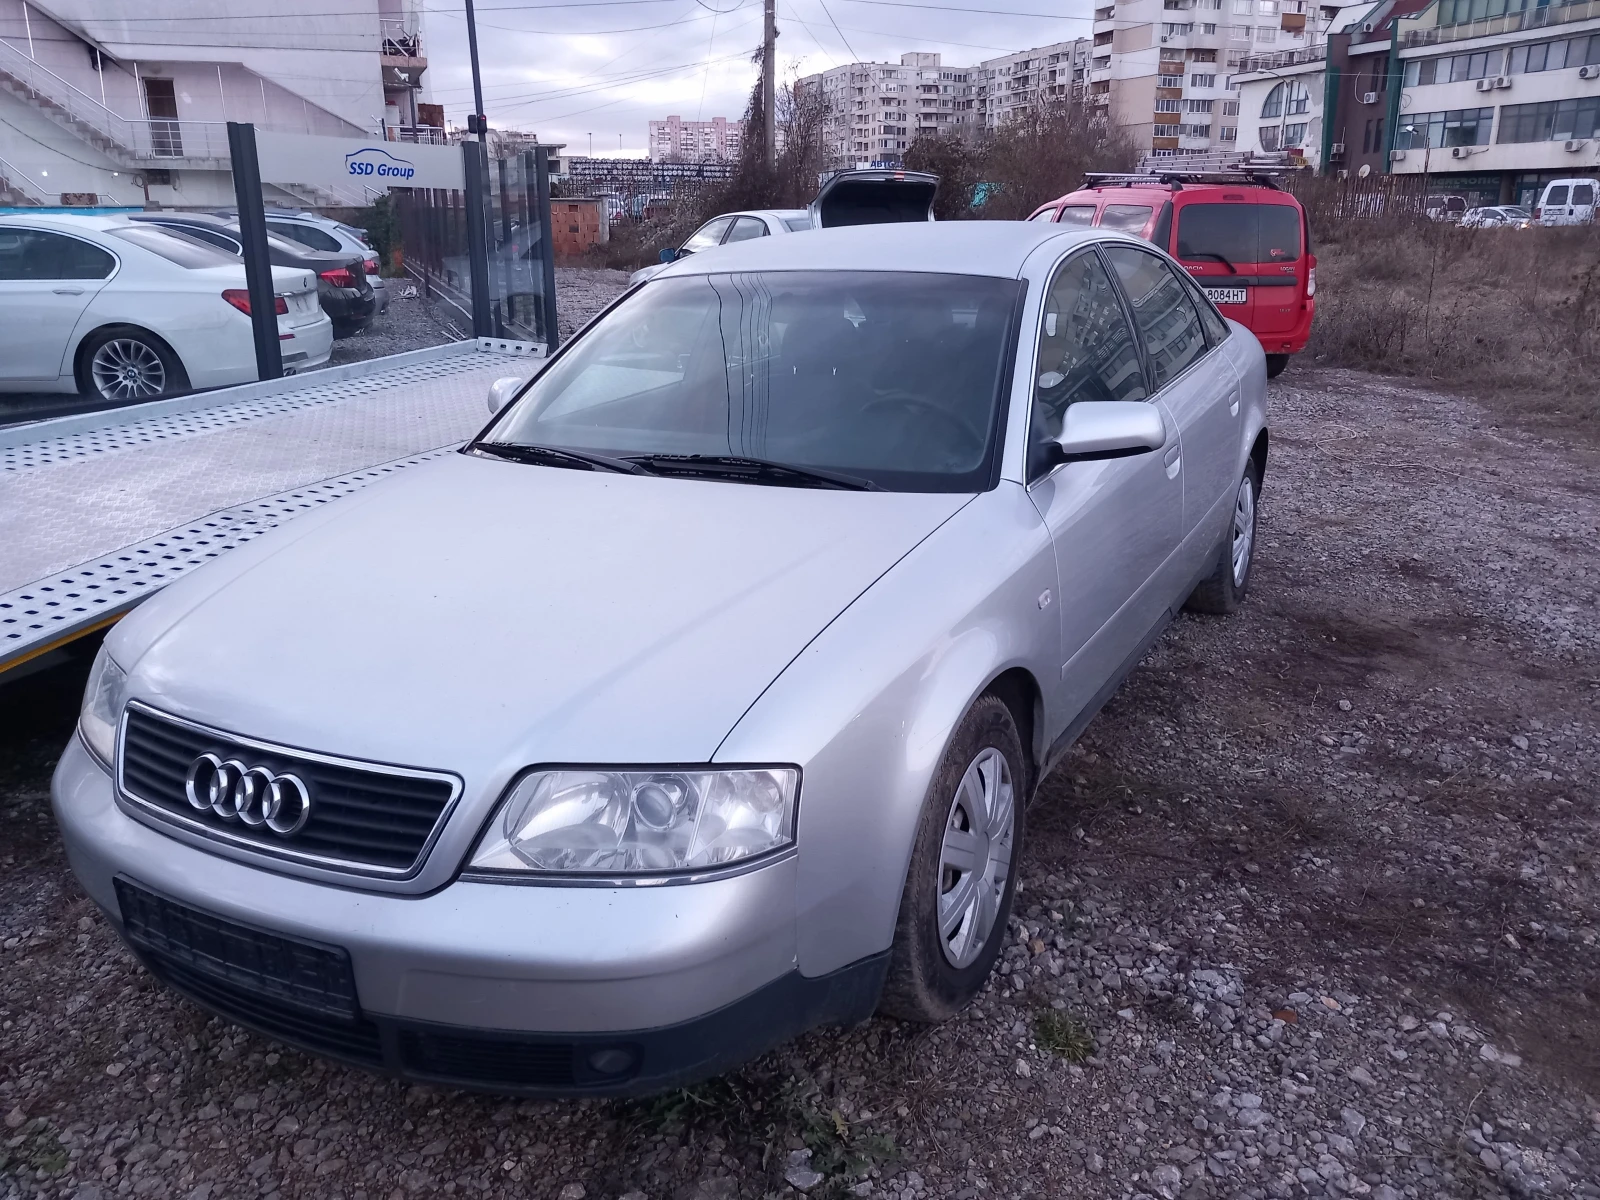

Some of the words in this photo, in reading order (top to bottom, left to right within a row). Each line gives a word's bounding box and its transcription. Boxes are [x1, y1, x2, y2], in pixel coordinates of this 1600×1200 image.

[349, 162, 374, 176] SSD
[377, 163, 415, 180] Group
[1207, 289, 1231, 300] 8084
[1232, 289, 1245, 301] HT
